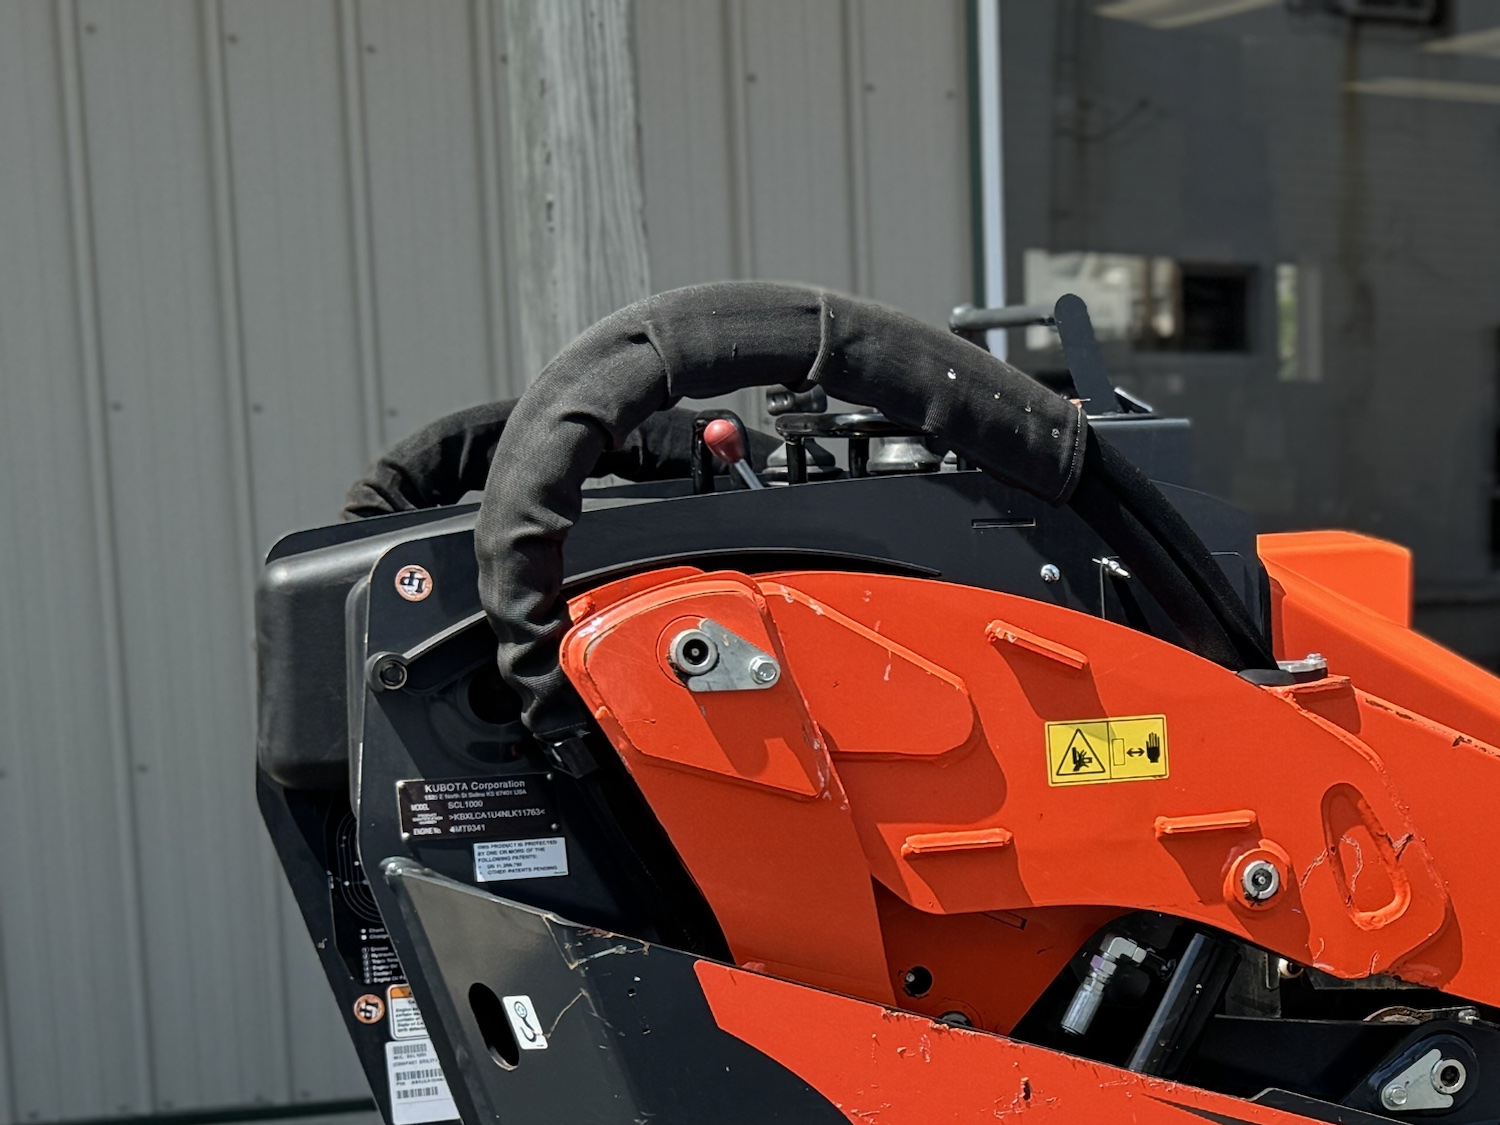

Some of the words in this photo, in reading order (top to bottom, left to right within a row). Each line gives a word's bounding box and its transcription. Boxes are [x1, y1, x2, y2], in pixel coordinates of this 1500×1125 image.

[424, 782, 469, 793] KUBOTA
[470, 780, 526, 791] Corporation
[514, 788, 528, 796] USA
[448, 800, 484, 810] SCL1000
